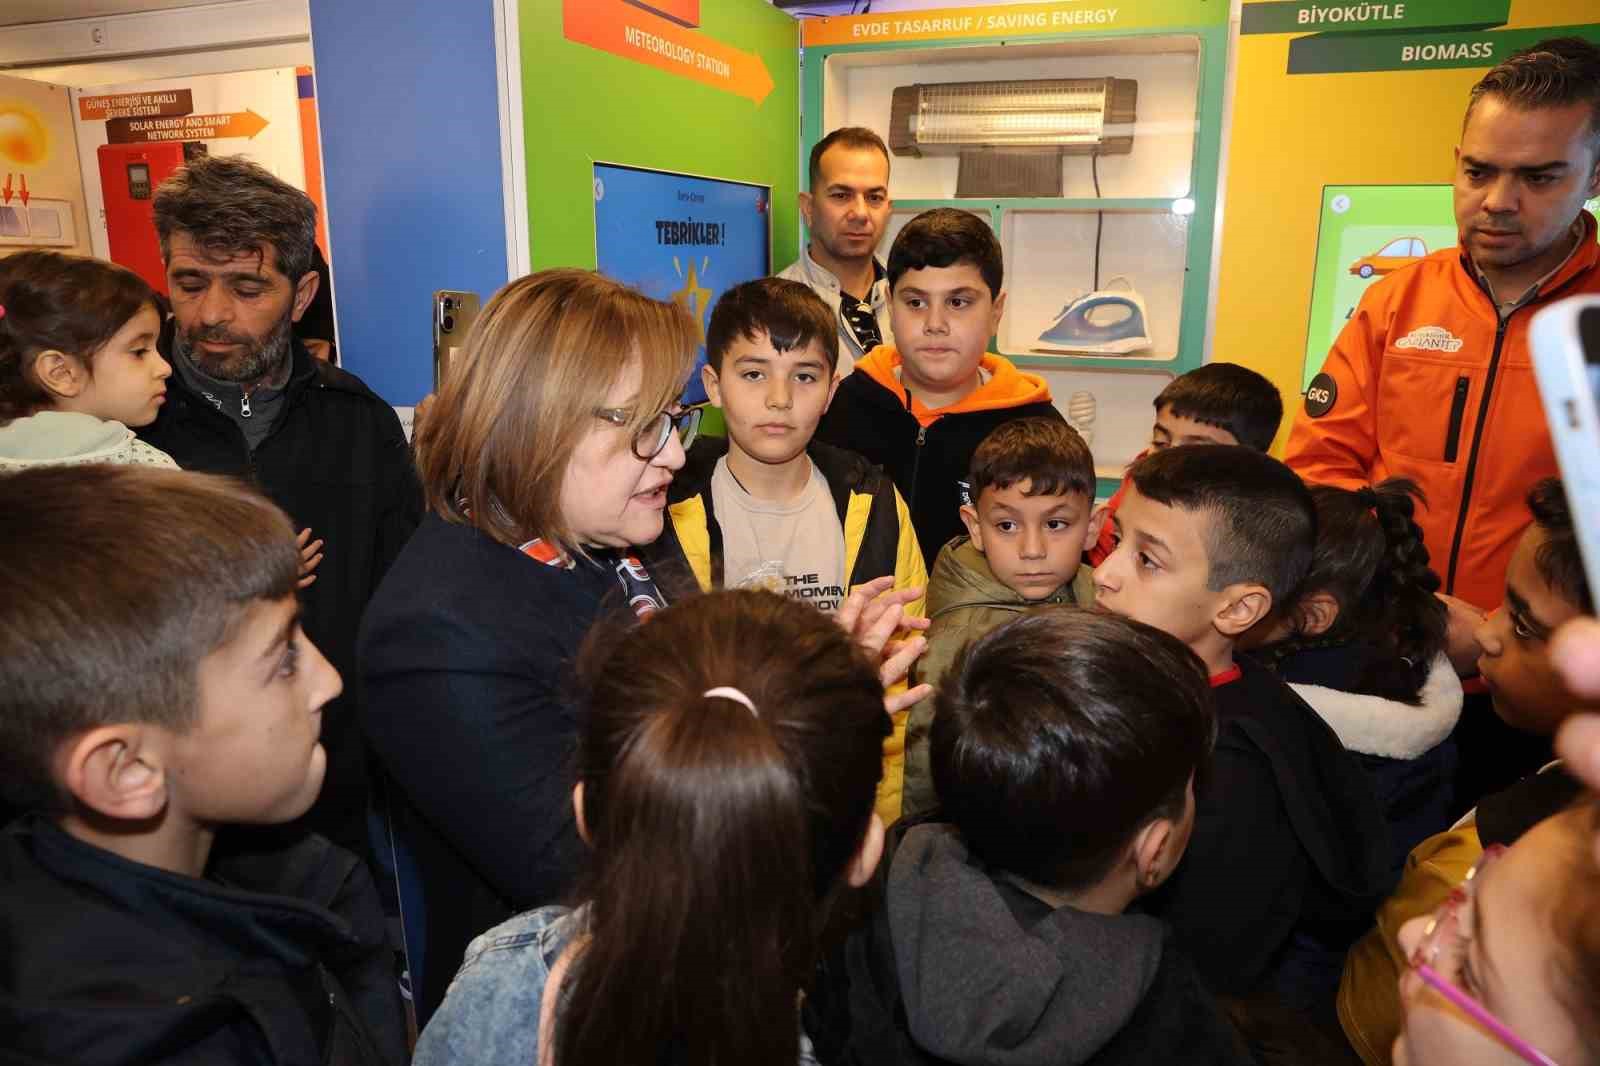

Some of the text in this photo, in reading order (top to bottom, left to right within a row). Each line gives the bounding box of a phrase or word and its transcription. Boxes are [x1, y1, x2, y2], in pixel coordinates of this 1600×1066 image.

[1297, 3, 1405, 24] BİYOKÜTLE
[853, 22, 889, 38] EVDE
[894, 17, 973, 34] TASARRUF
[987, 12, 1047, 30] SAVING
[1052, 8, 1119, 25] ENERGY
[624, 25, 731, 79] METEOROLOGY STATION
[1401, 42, 1494, 61] BIOMASS
[142, 94, 152, 105] VE
[129, 115, 231, 132] SOLAR ENERGY AND SMART
[147, 127, 215, 141] NETWORK SYSTEM
[1308, 387, 1330, 403] GKS
[784, 573, 819, 586] THE
